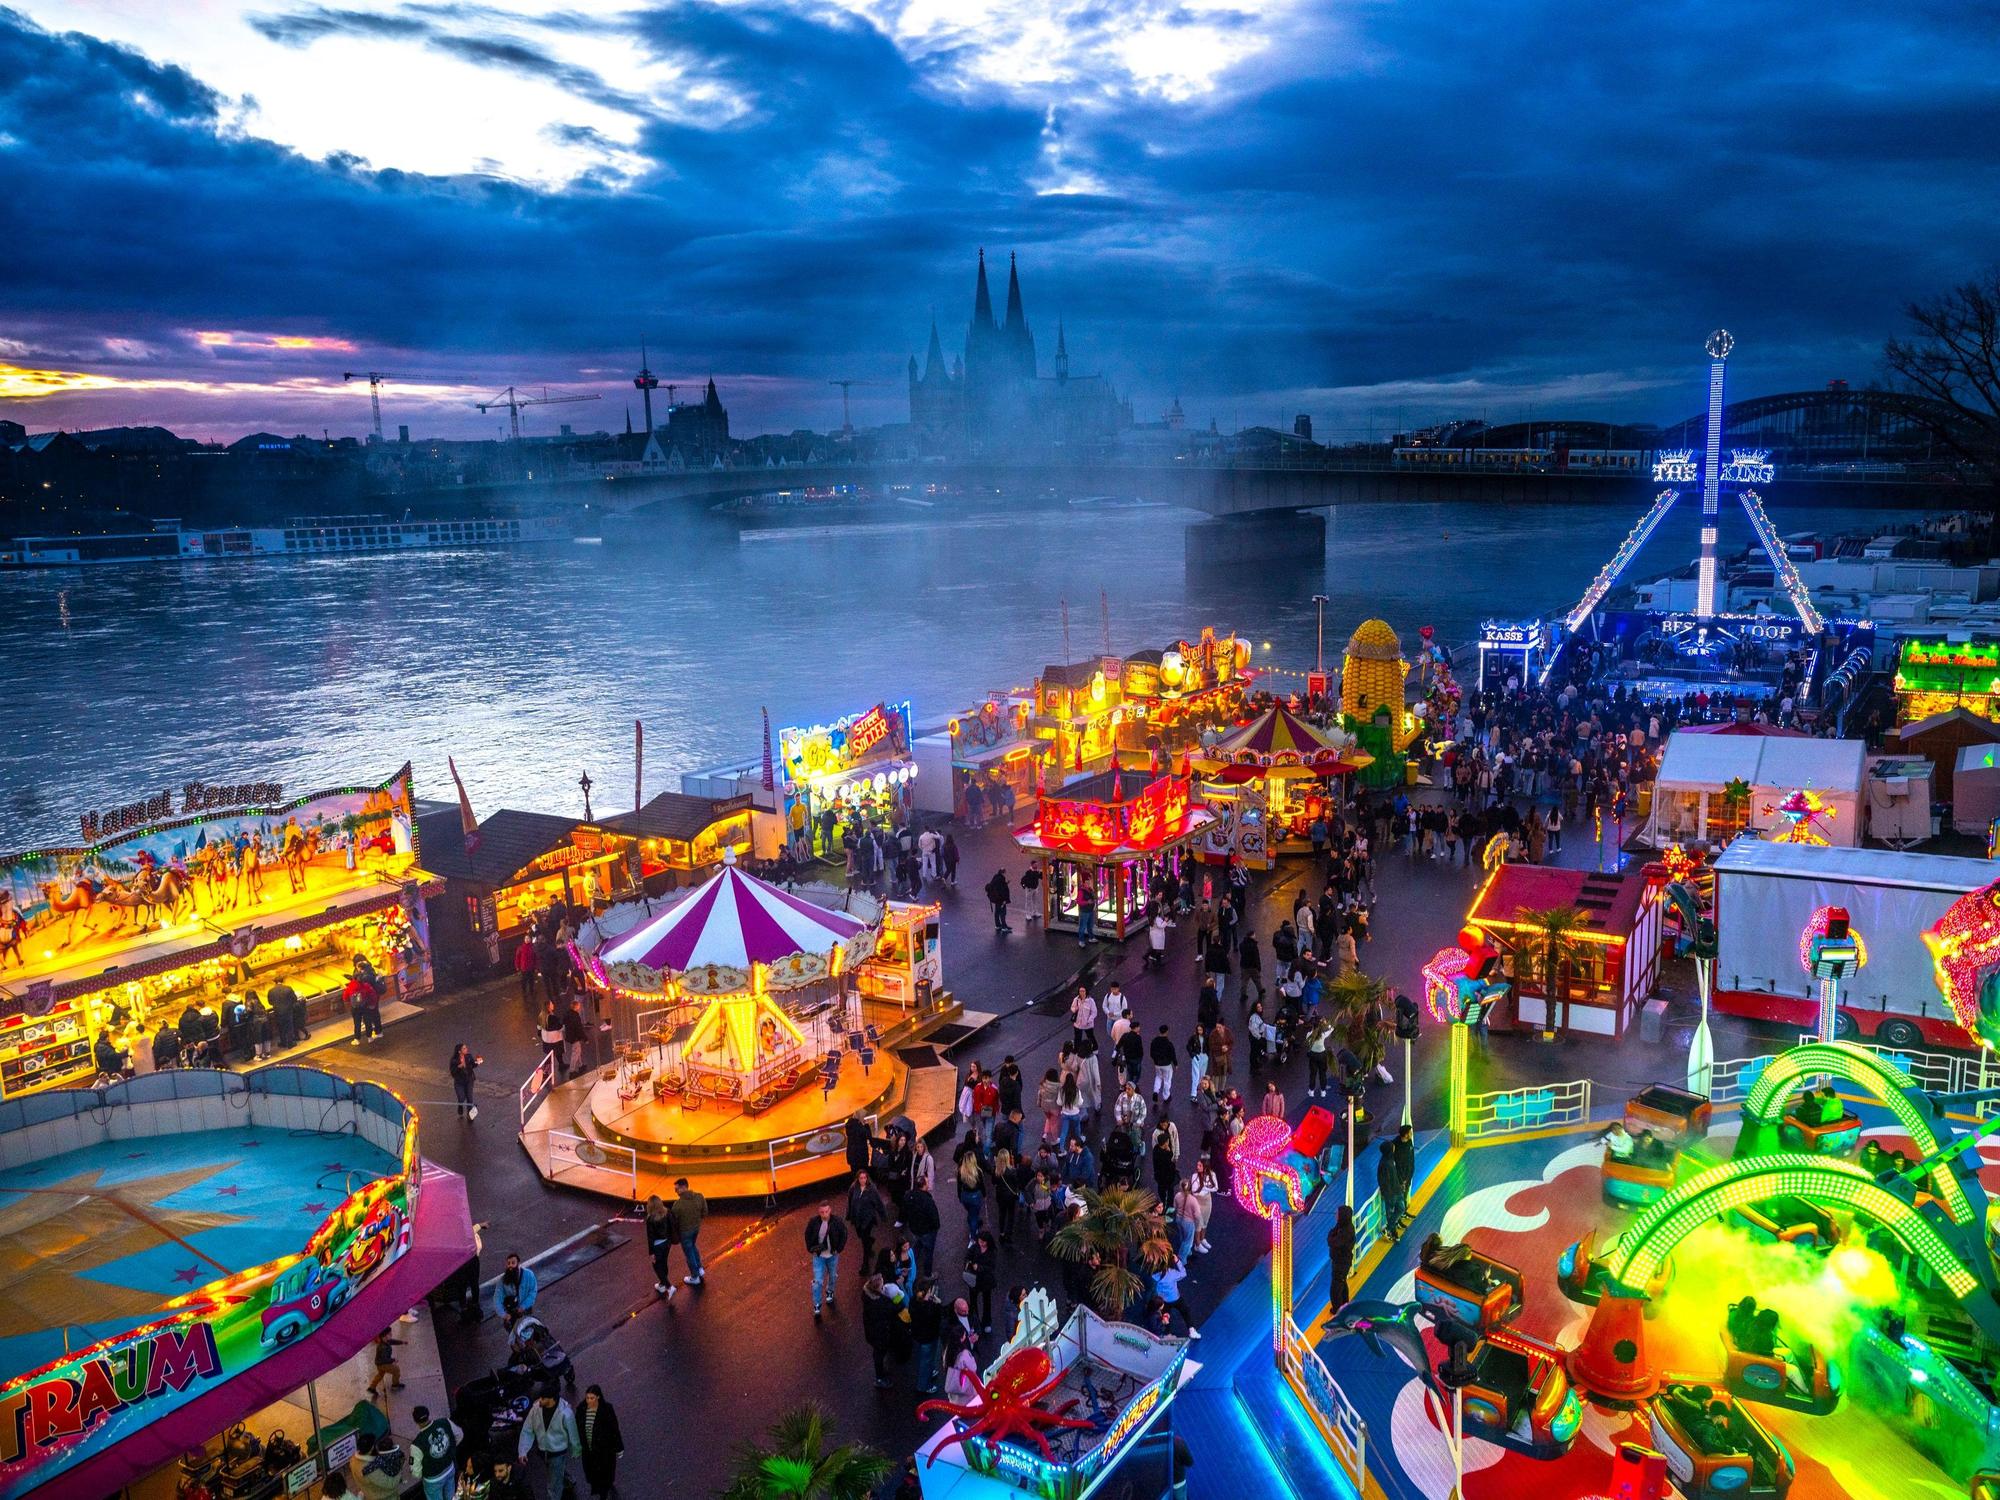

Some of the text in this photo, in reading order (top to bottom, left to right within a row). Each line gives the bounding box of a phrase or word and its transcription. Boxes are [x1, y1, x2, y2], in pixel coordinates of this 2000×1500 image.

[1652, 463, 1774, 483] THE KING
[1662, 620, 1696, 633] BES
[1486, 631, 1523, 641] KASSE
[80, 782, 283, 843] Kamel Rennen
